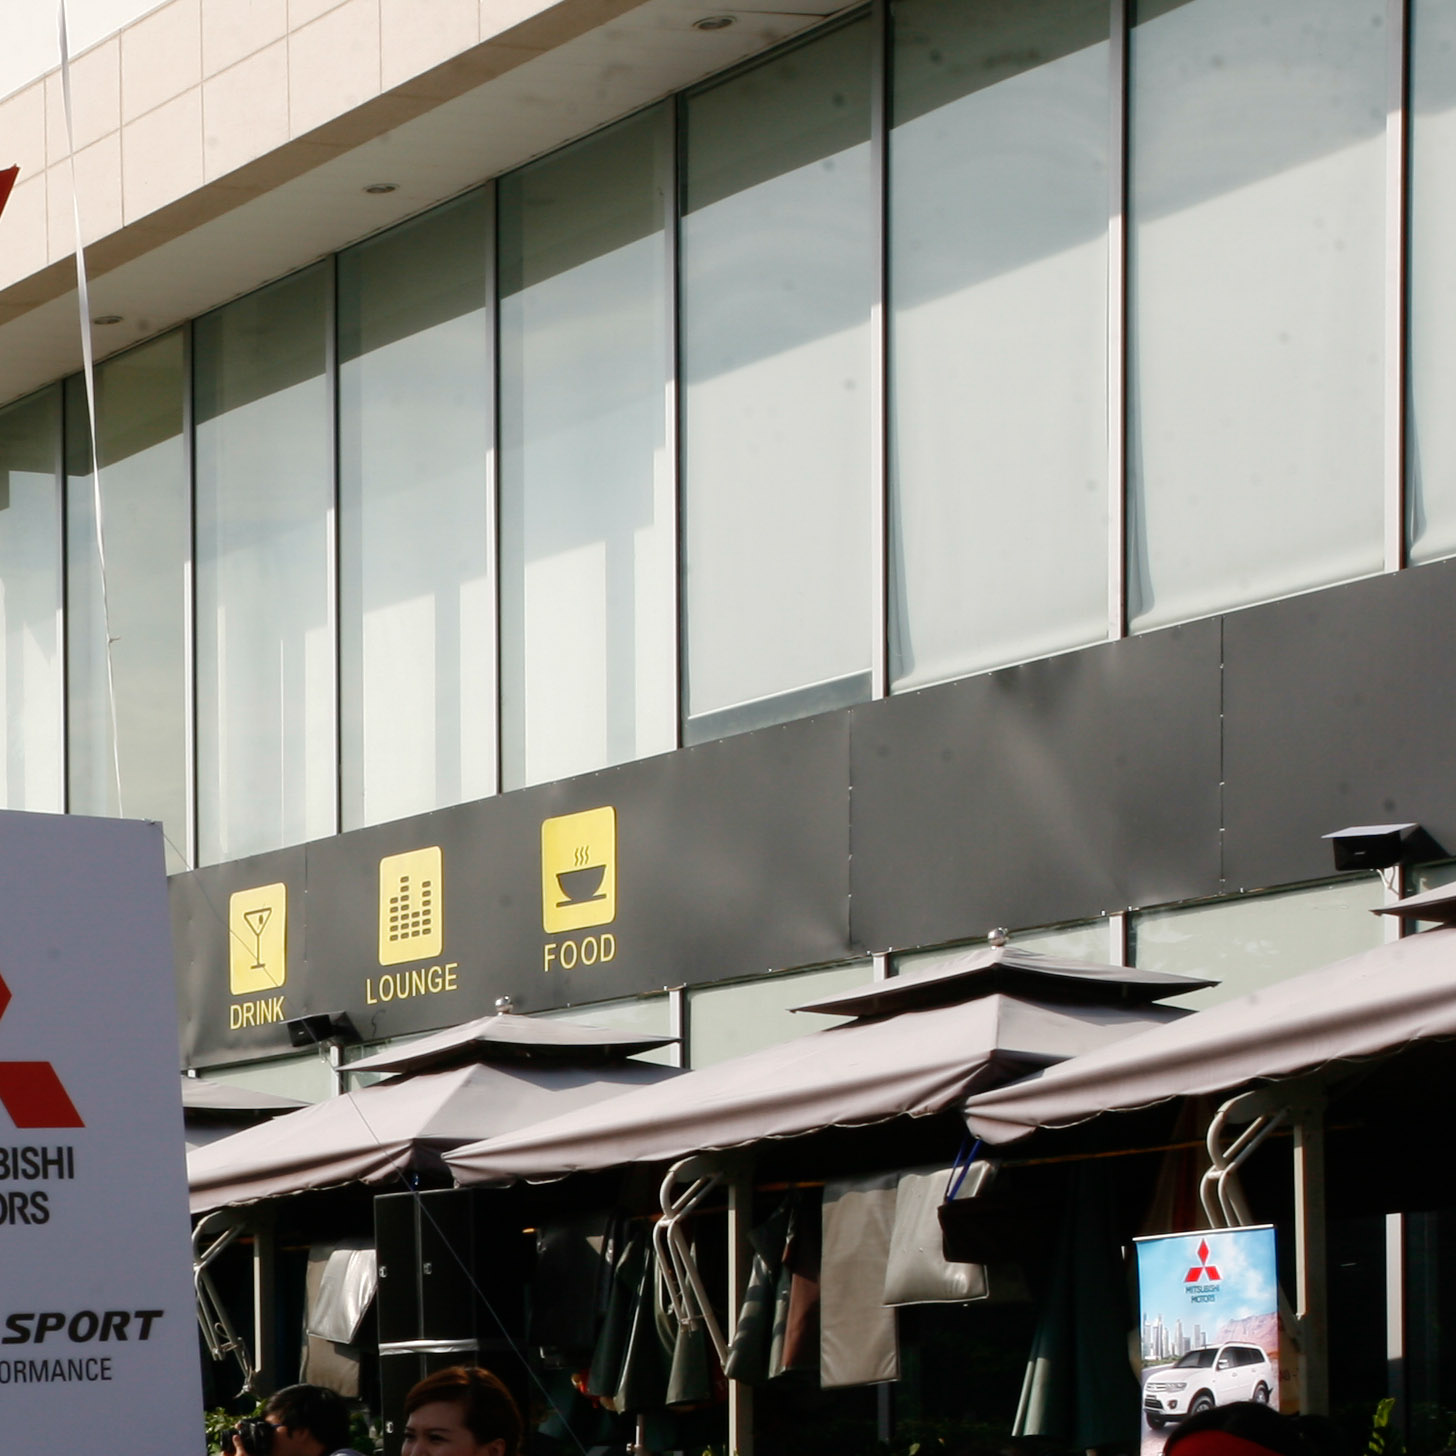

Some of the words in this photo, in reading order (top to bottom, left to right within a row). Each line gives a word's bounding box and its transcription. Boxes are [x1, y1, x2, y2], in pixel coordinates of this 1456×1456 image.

[543, 933, 616, 972] FOOD
[366, 963, 458, 1005] LOUNGE
[230, 996, 285, 1029] DRINK
[1, 1310, 164, 1345] SPORT
